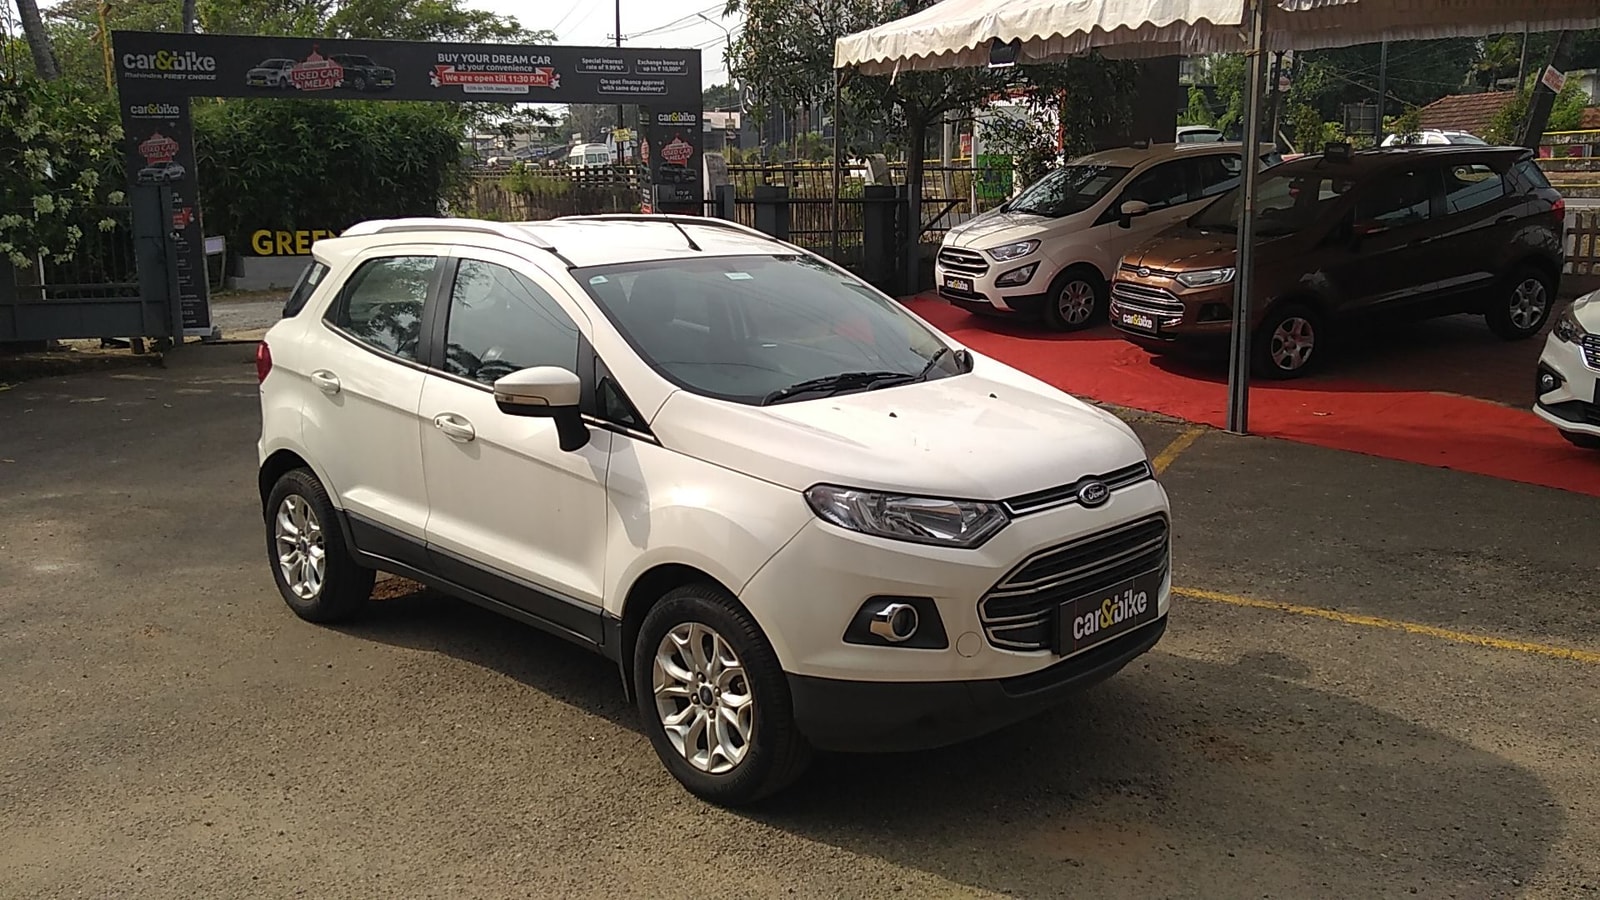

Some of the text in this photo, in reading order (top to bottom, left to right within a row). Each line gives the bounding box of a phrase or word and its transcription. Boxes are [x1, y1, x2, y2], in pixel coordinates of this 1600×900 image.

[123, 50, 216, 71] car&bike
[438, 53, 551, 65] BUY YOUR DREAM CAR
[294, 69, 340, 80] USED CAR
[304, 78, 331, 88] MELA
[130, 104, 179, 114] car&bike
[658, 112, 696, 121] car&bike
[1123, 313, 1152, 328] car&bike
[1088, 486, 1104, 500] Ford
[1073, 589, 1147, 640] car&bike
